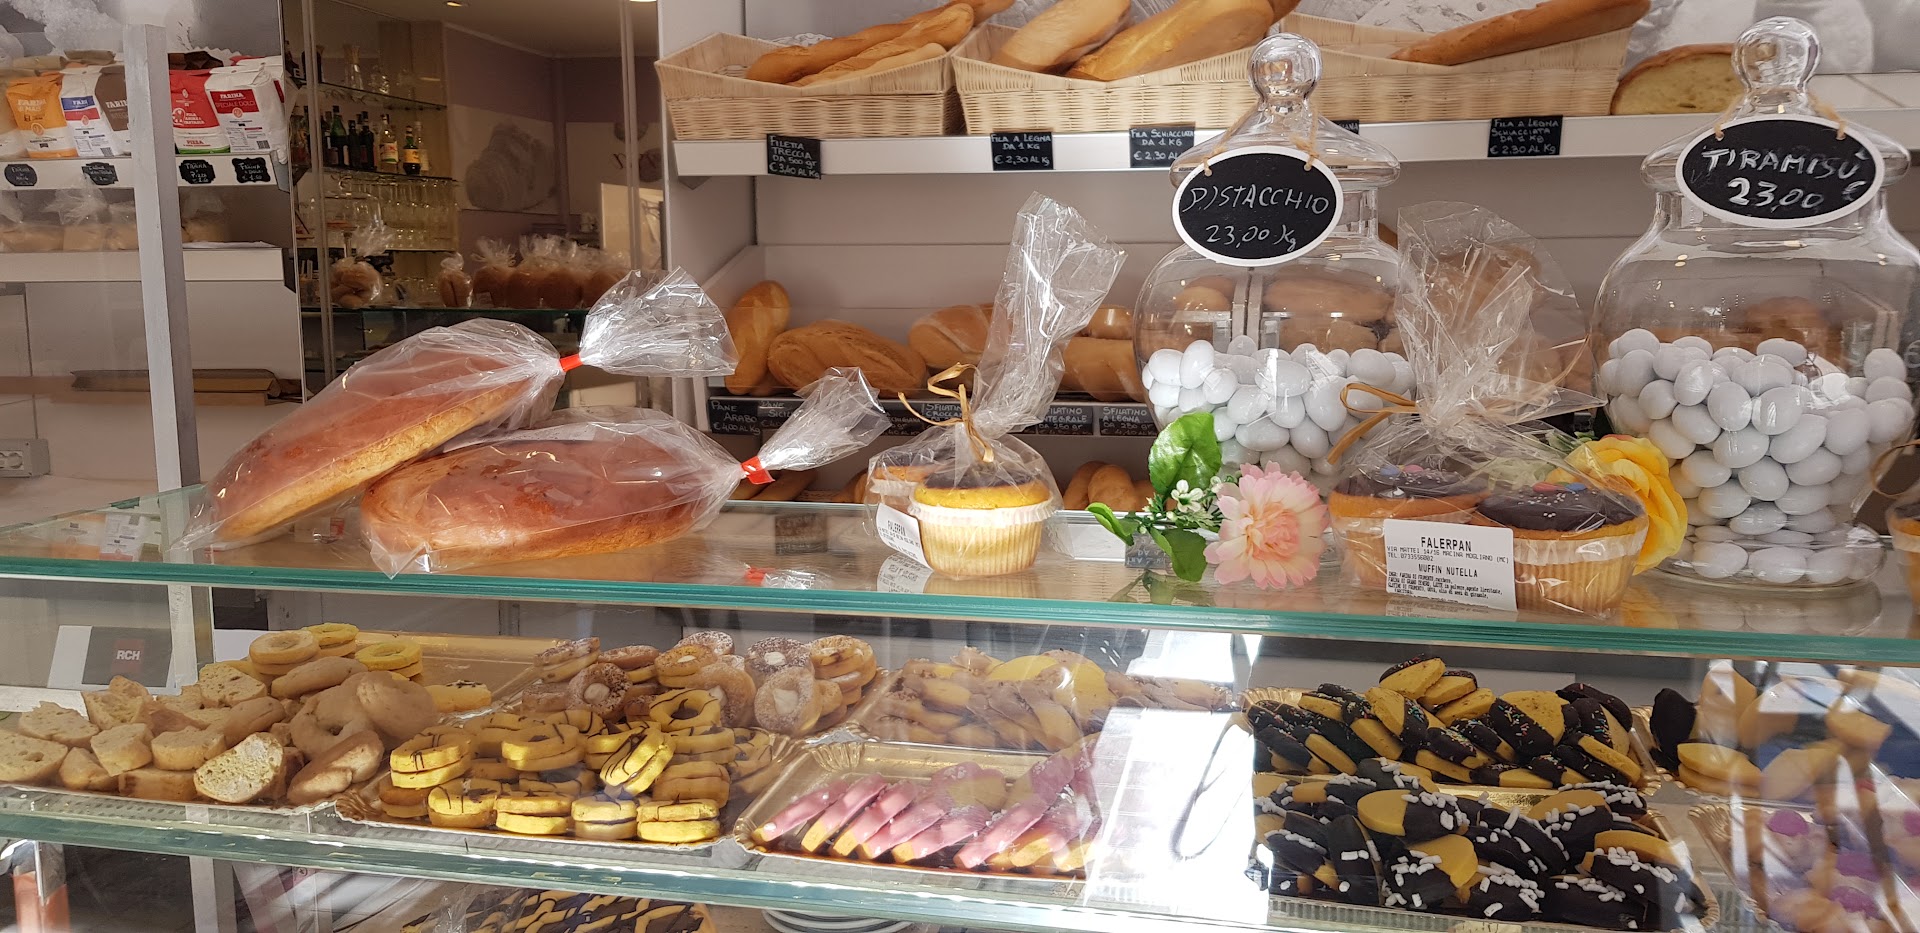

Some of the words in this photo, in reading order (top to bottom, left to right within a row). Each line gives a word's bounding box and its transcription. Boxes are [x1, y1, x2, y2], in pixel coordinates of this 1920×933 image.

[1528, 118, 1559, 127] LEGNA
[1024, 134, 1052, 142] LEGNA
[1002, 142, 1016, 150] DA
[772, 154, 786, 162] DA
[994, 154, 1004, 164] €
[1134, 150, 1142, 160] €
[1182, 184, 1329, 214] PISTACCHIO
[1727, 177, 1824, 214] 23,00
[1205, 224, 1270, 248] 23,00
[711, 400, 738, 412] PANE
[1102, 406, 1148, 416] SFILATINO
[724, 412, 758, 423] ARABO
[1044, 415, 1088, 423] NTEGRALE
[1420, 536, 1472, 552] FALERPAN
[1442, 550, 1464, 558] MACINA
[1466, 552, 1494, 561] MOGLIANO
[1418, 564, 1442, 574] MUFFIN
[1446, 566, 1478, 578] NUTELLA
[116, 650, 141, 661] RCH
